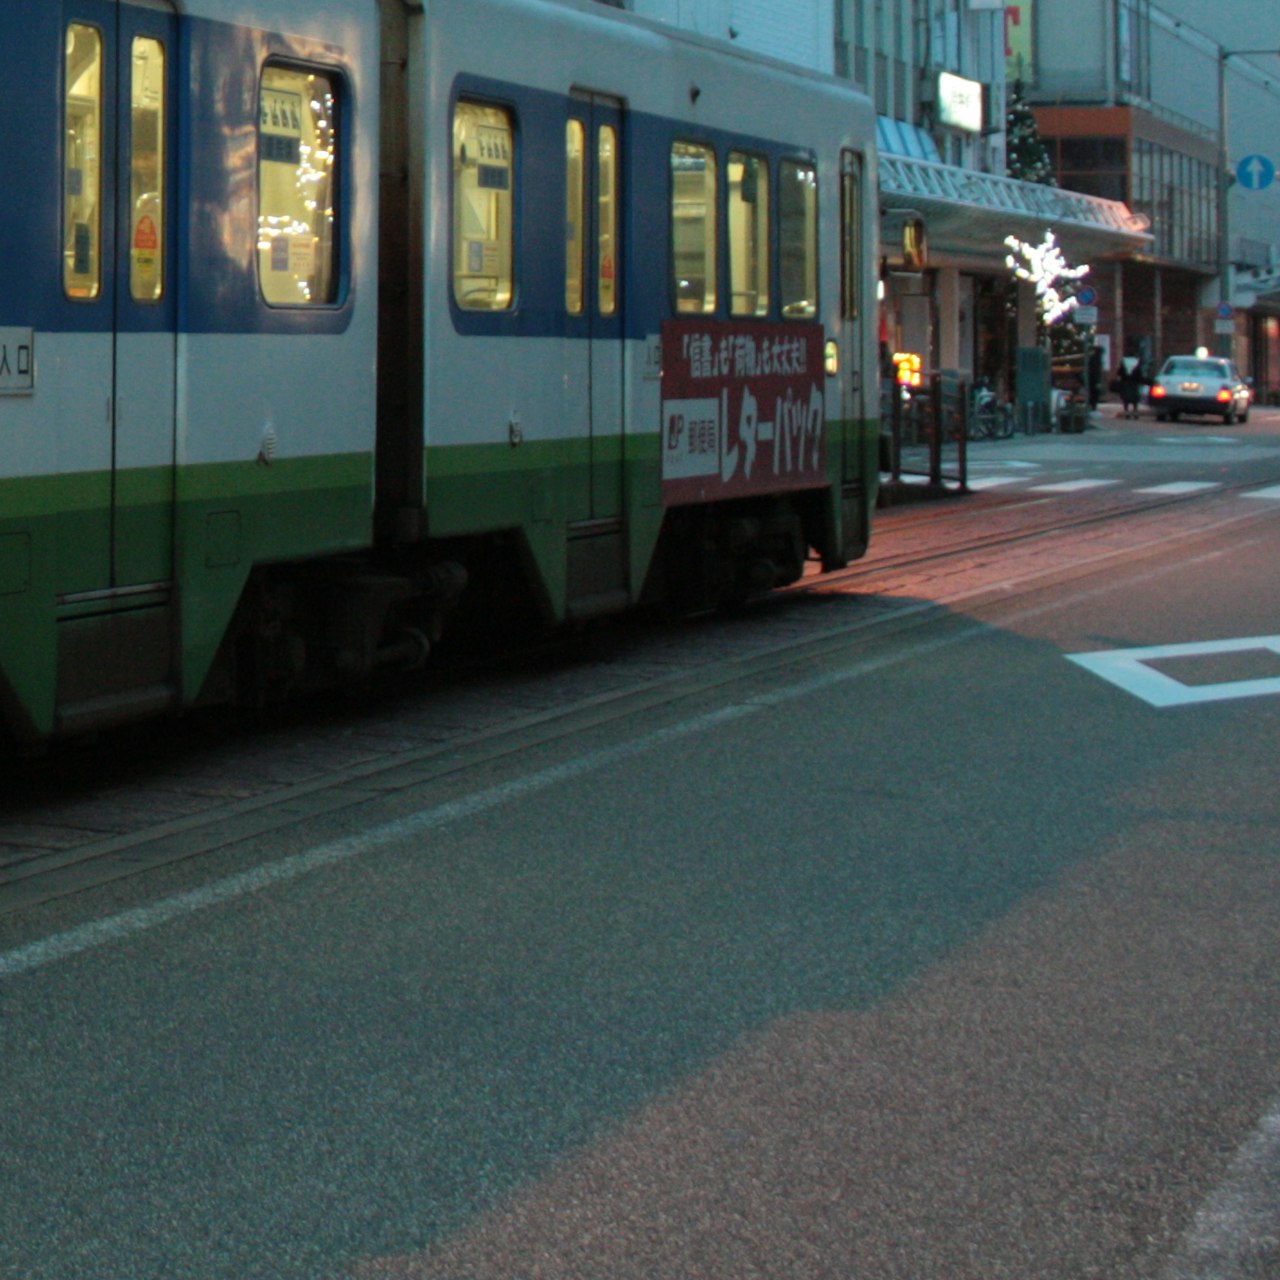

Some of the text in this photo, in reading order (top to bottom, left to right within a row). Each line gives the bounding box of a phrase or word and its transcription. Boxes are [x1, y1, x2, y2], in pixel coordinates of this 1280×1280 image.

[0, 344, 29, 376] 入口
[720, 382, 824, 484] レターパック
